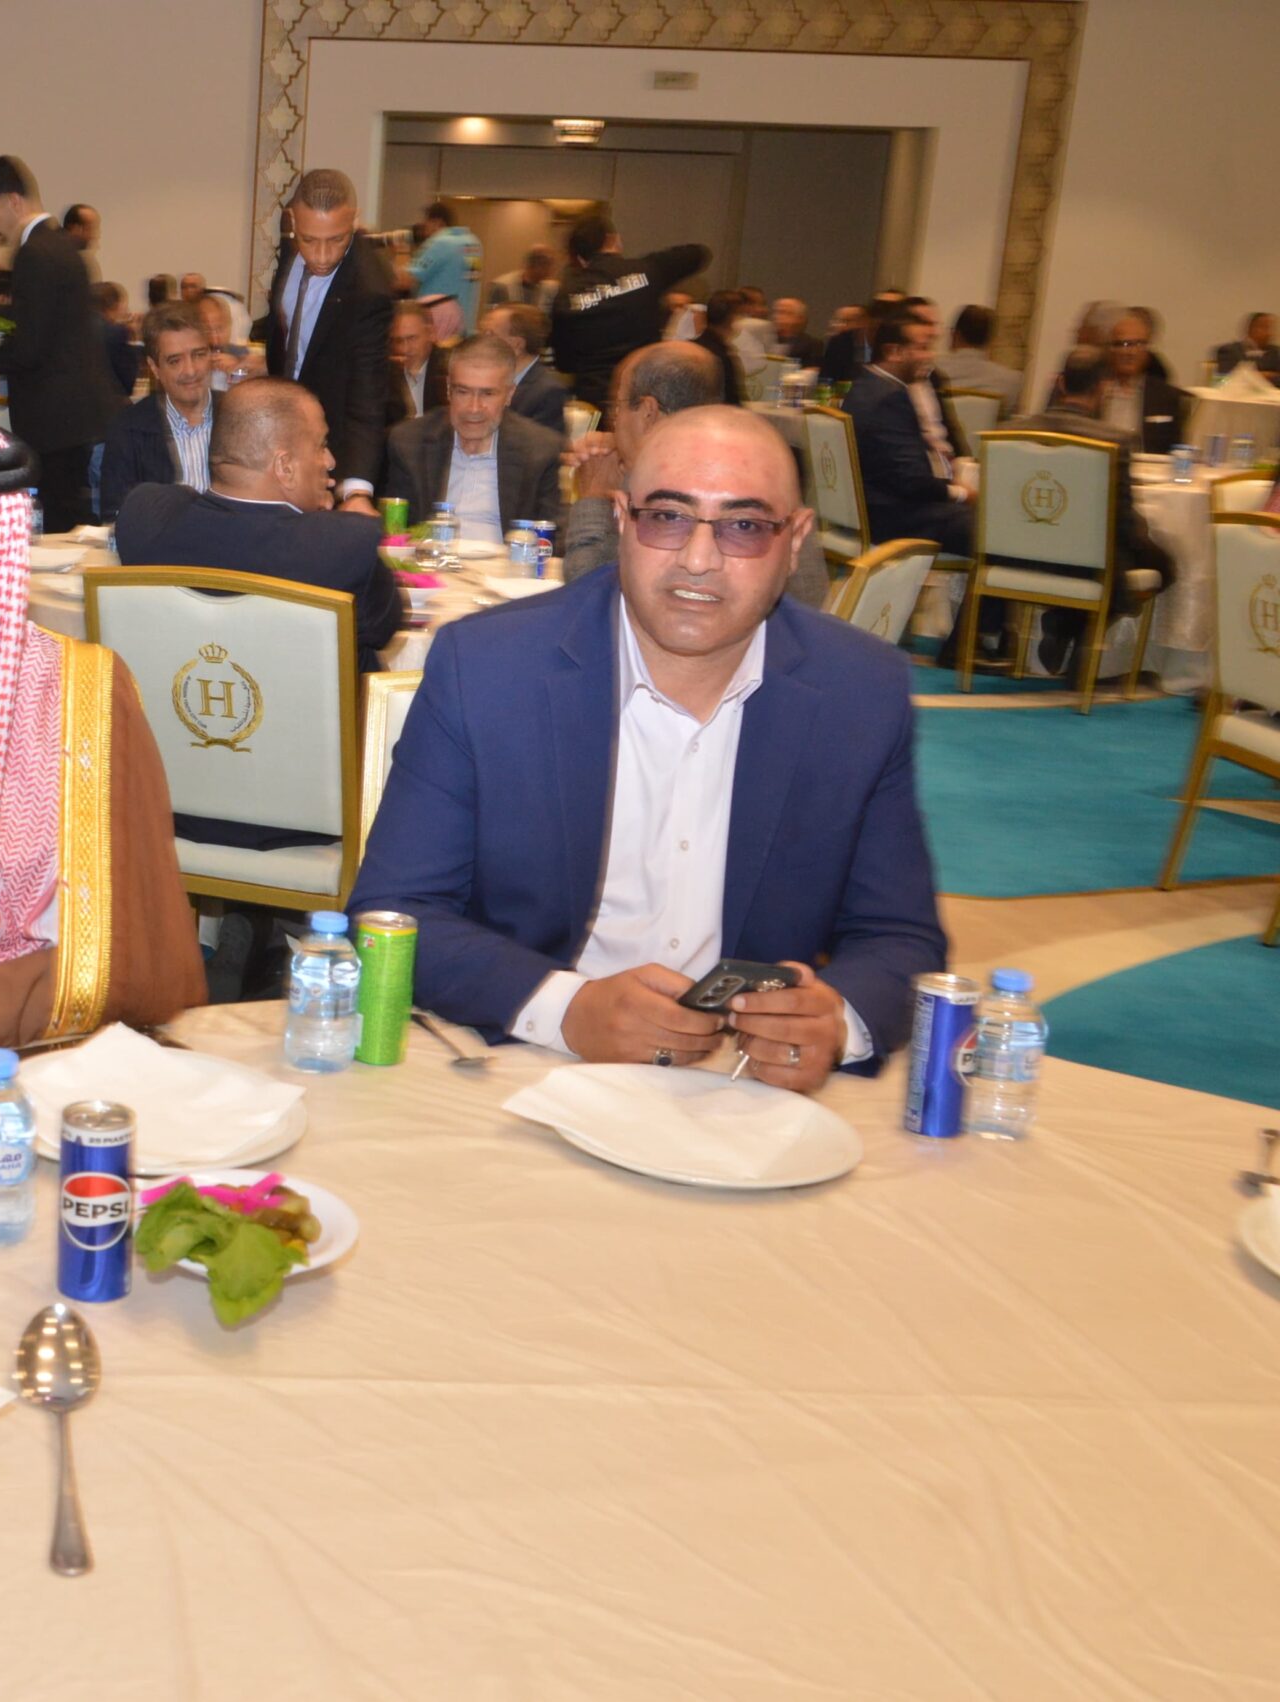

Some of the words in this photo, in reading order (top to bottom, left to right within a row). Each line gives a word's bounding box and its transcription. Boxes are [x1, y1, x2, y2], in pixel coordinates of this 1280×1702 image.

[1035, 487, 1055, 508] H
[196, 678, 238, 719] H
[63, 1197, 128, 1219] PEPSI
